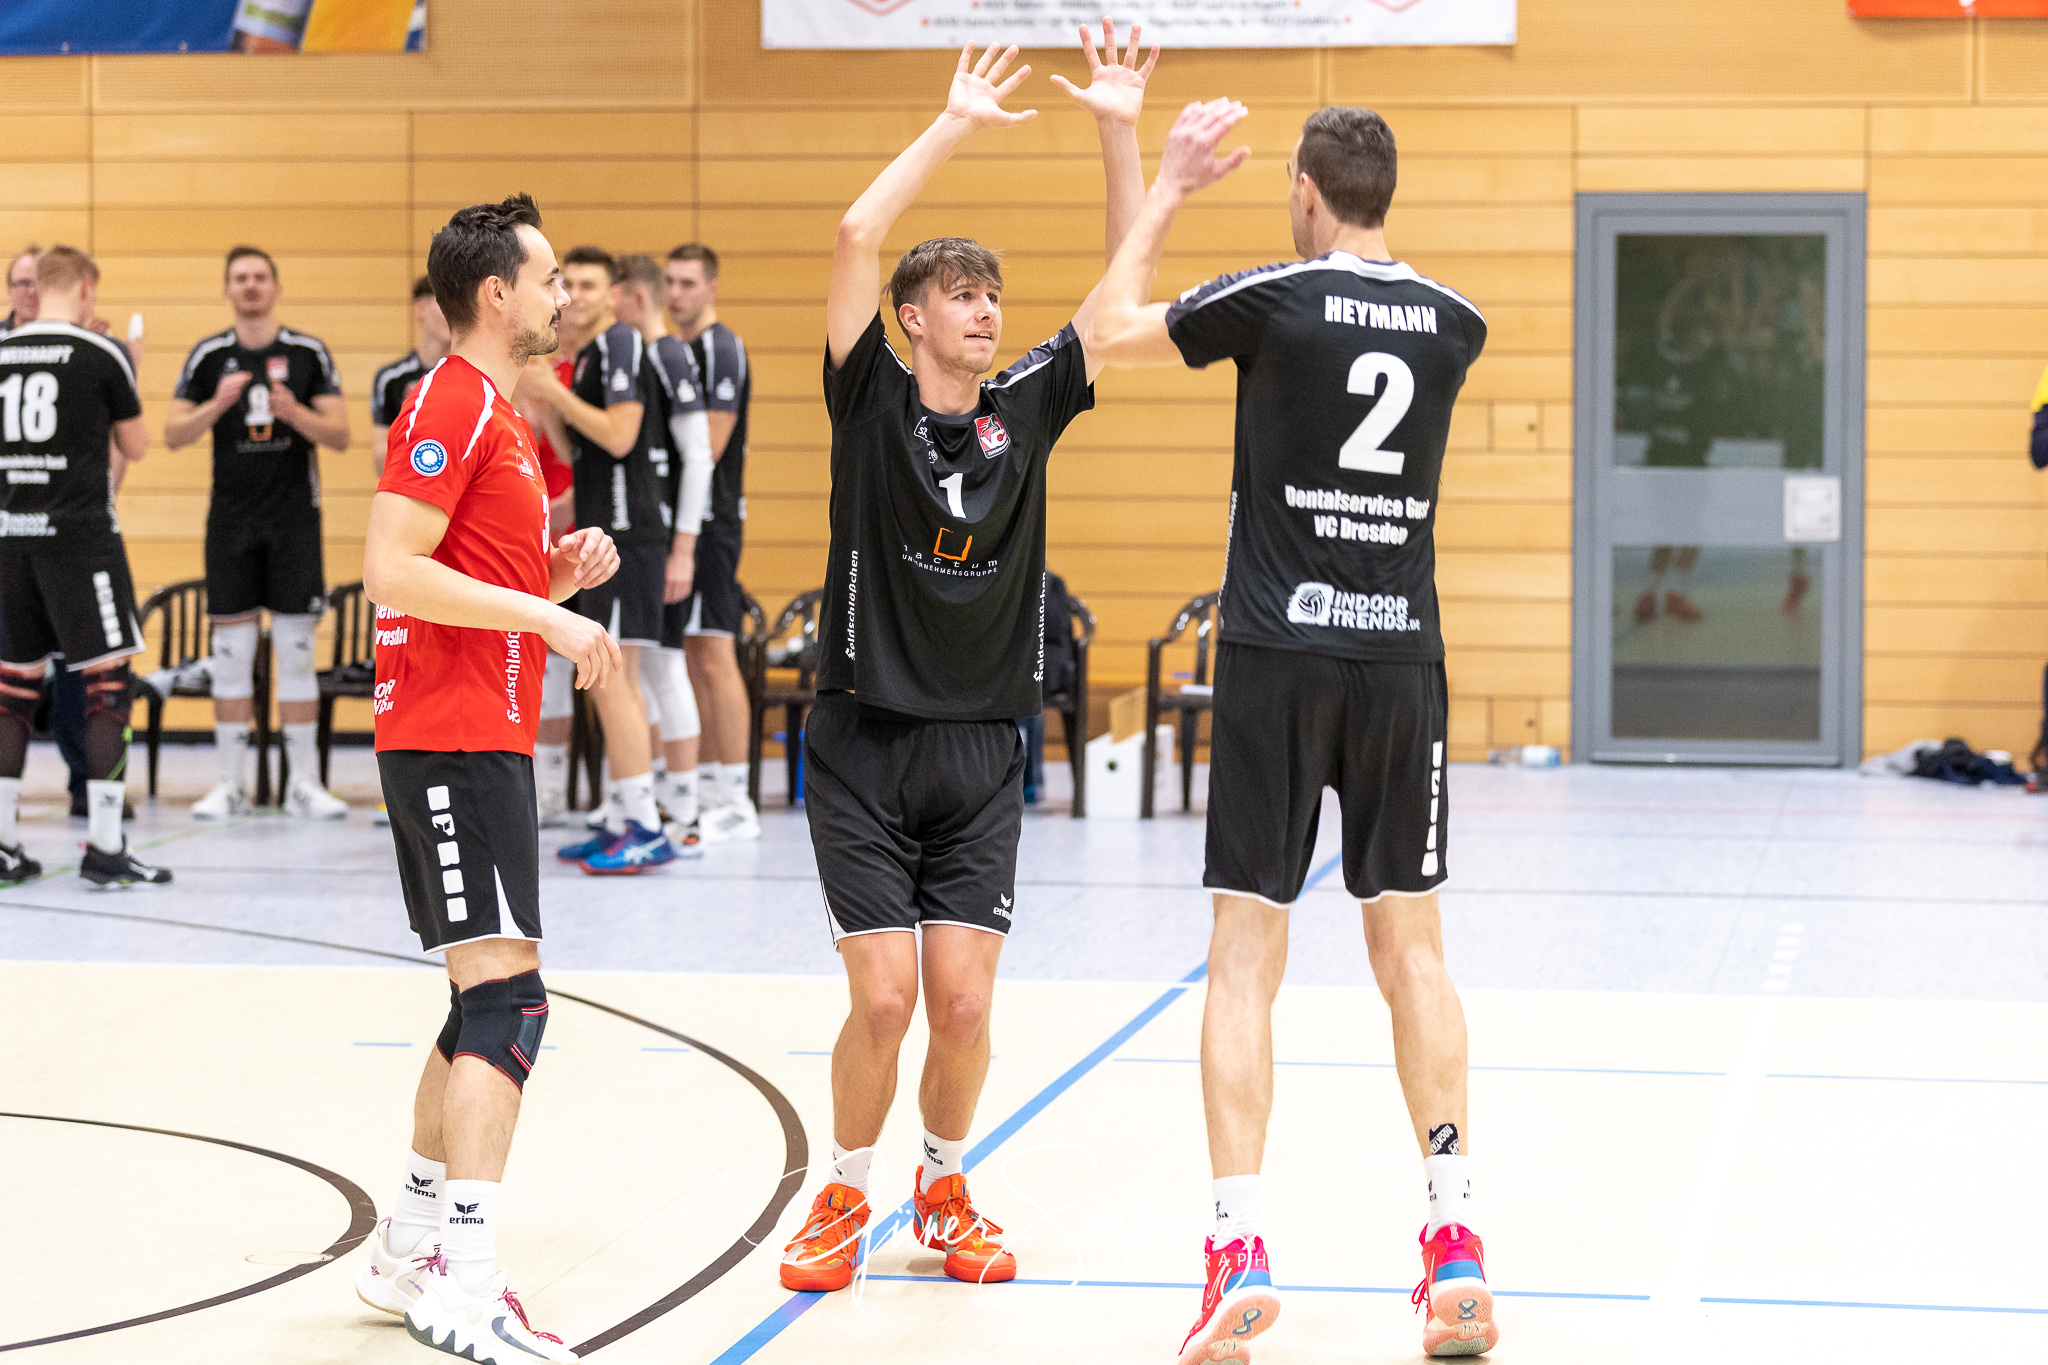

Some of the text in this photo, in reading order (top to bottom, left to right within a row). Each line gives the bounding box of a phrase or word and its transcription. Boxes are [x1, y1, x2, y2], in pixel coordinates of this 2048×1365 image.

[1324, 295, 1438, 335] HEYMANN
[0, 370, 59, 443] 18
[1338, 351, 1415, 475] 2
[980, 428, 1008, 450] VC
[938, 473, 967, 519] 1
[1284, 484, 1404, 520] Dentalservice
[1313, 515, 1339, 538] VC
[902, 553, 998, 578] UNRNEHMENSGRUPPE
[1333, 590, 1409, 616] INDOOR
[376, 625, 409, 647] resden
[405, 1183, 437, 1199] erima
[449, 1214, 485, 1225] erima
